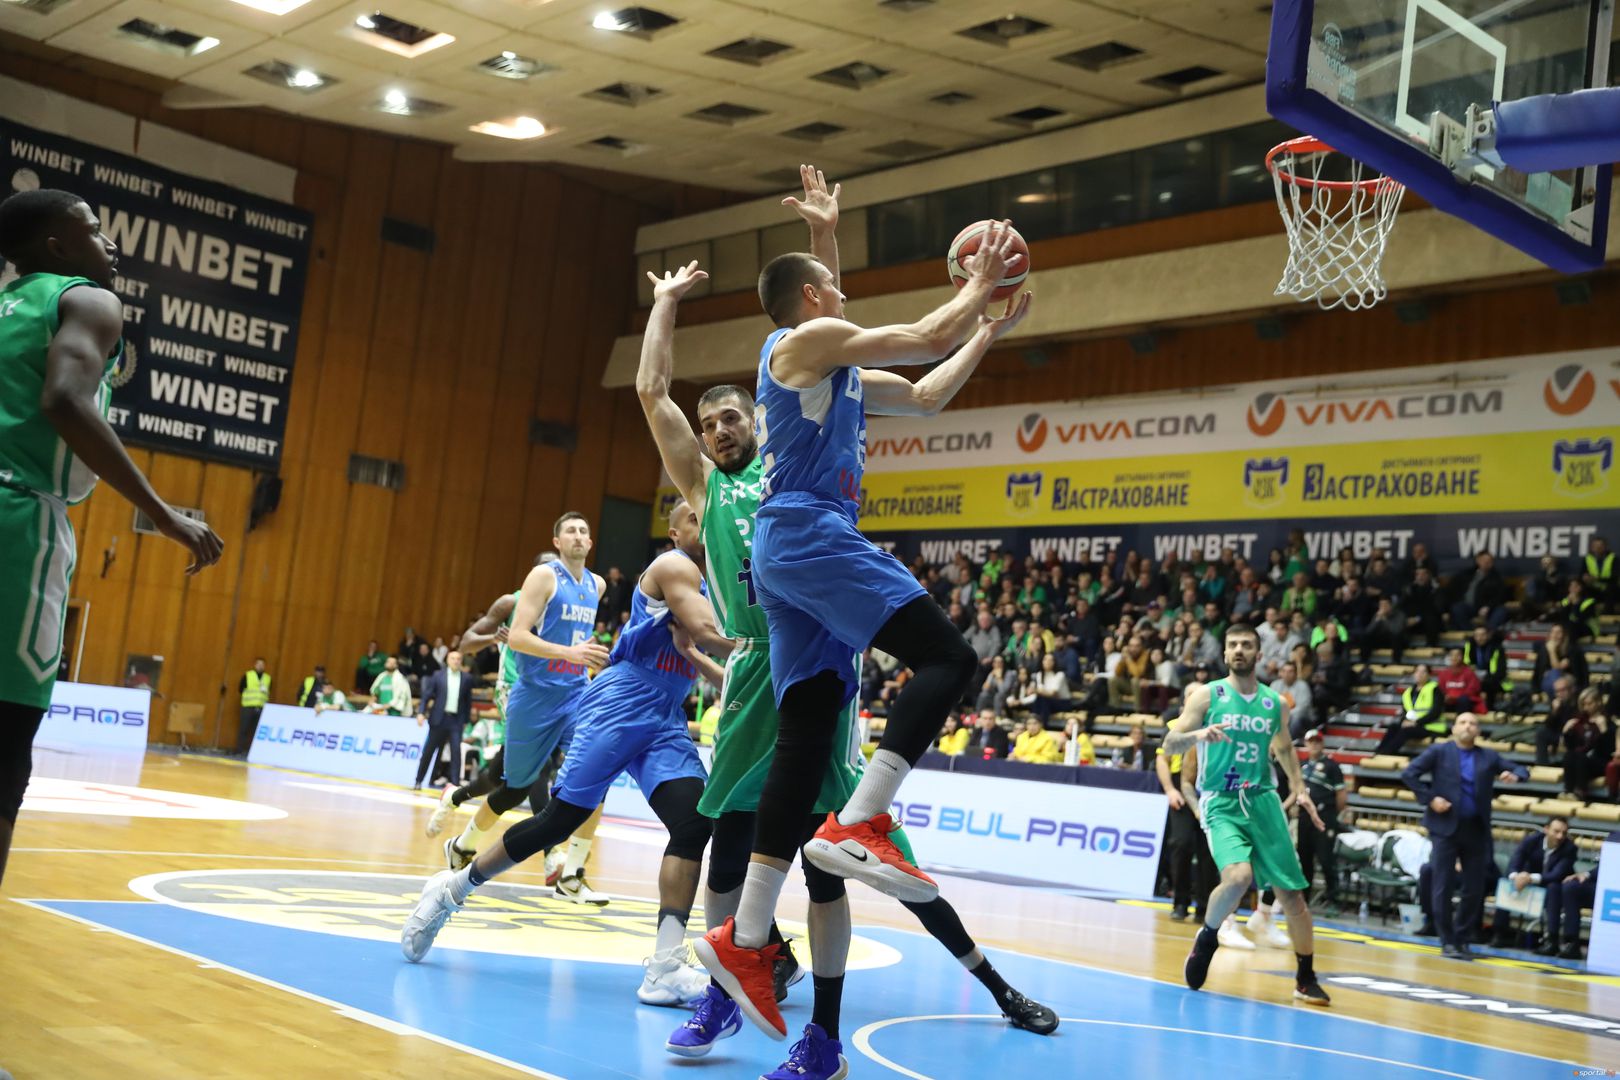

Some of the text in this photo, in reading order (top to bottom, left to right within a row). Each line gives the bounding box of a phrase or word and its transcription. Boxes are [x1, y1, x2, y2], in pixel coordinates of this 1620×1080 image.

[10, 139, 308, 240] WINBET WINBET WINBET WINBET
[99, 205, 293, 296] WINBET
[160, 294, 289, 352] WINBET
[150, 336, 288, 384] WINBET WINBET
[150, 369, 279, 425] WINBET
[1296, 390, 1504, 425] VIVACOM
[138, 412, 206, 441] WINBET
[213, 429, 278, 457] WINBET
[865, 431, 993, 457] VIVACOM
[1056, 413, 1216, 443] VIVACOM
[1052, 477, 1190, 511] ЗАСТРАХОВАНЕ
[1303, 464, 1480, 501] ЗАСТРАХОВАНЕ
[1457, 526, 1597, 559] WINBET
[1222, 713, 1273, 735] BEROE
[1235, 741, 1259, 763] 23
